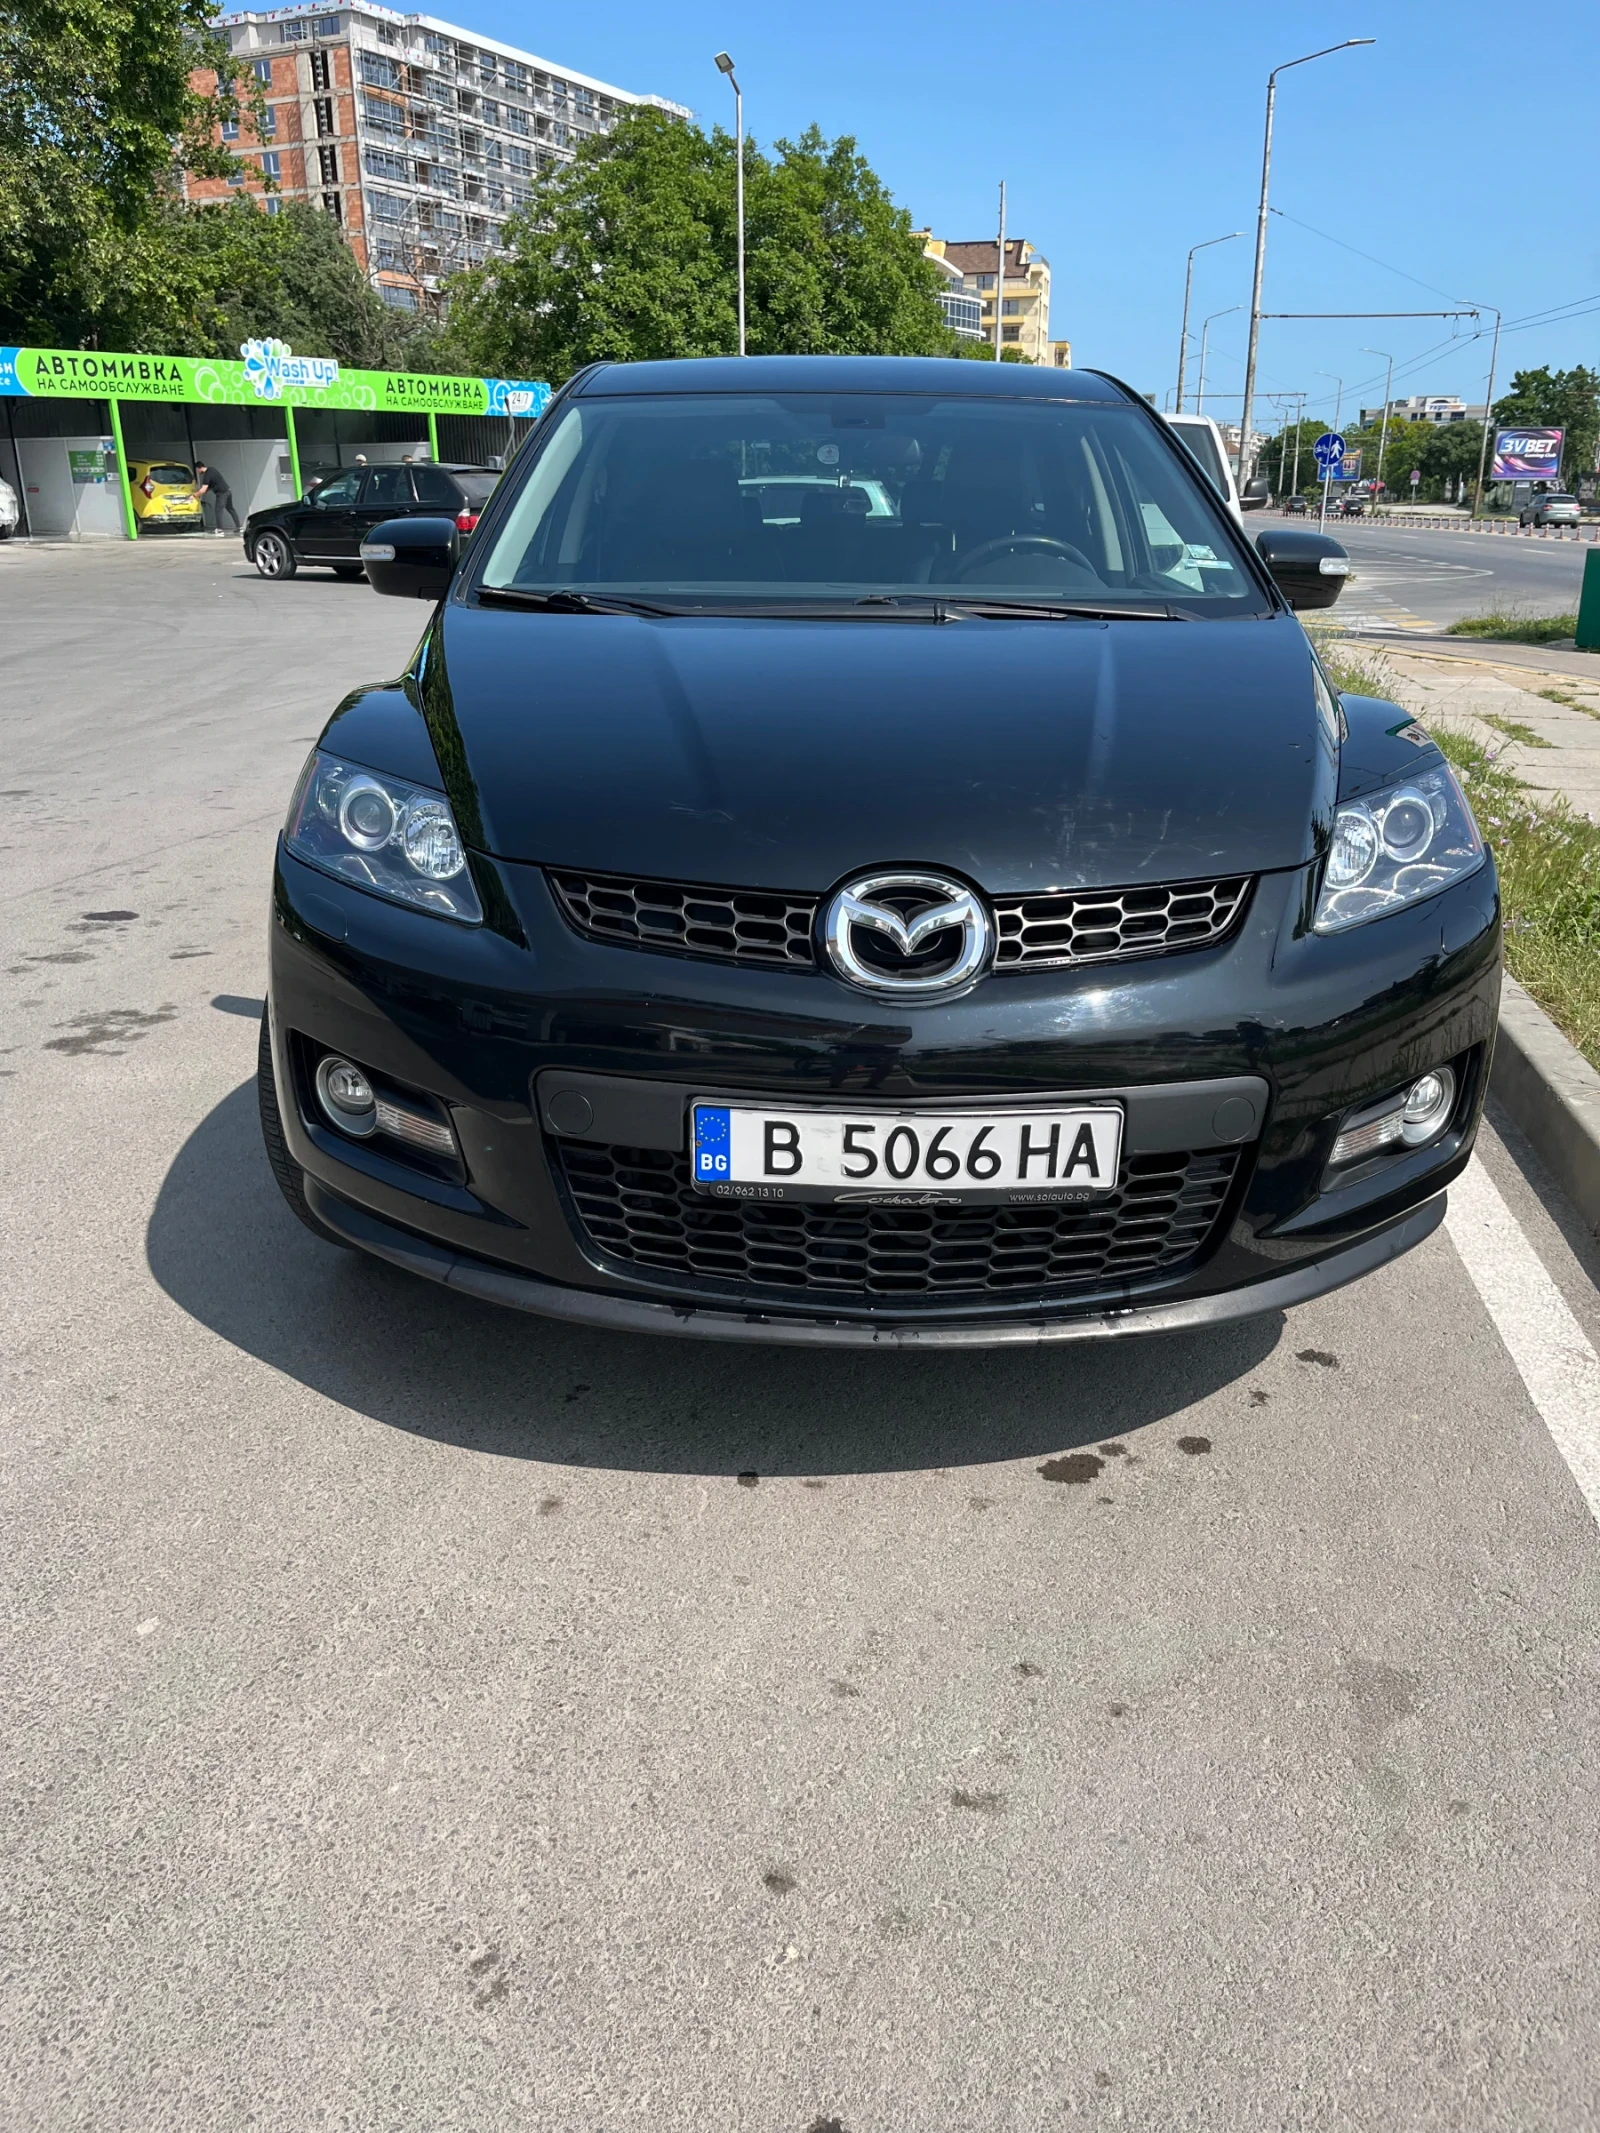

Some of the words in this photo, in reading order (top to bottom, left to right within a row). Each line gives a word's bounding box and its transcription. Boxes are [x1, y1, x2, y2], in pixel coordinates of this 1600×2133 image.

[36, 355, 183, 381] АВТОМИВКА
[265, 357, 310, 379] Wash
[312, 360, 338, 386] Up!
[37, 378, 56, 390] НА
[60, 378, 185, 396] САМООБСЛУЖВАНЕ
[386, 377, 483, 399] АВТОМИВКА
[386, 395, 399, 406] НА
[401, 396, 484, 410] САМООБСЛУЖВАНЕ
[511, 391, 529, 405] 24/7
[1501, 439, 1557, 453] 3VBET
[763, 1119, 804, 1176] B
[842, 1122, 1002, 1180] 5066
[1017, 1122, 1101, 1179] HA
[700, 1153, 727, 1172] BG
[716, 1184, 755, 1197] 02/962
[757, 1186, 769, 1197] 13
[772, 1187, 784, 1198] 10
